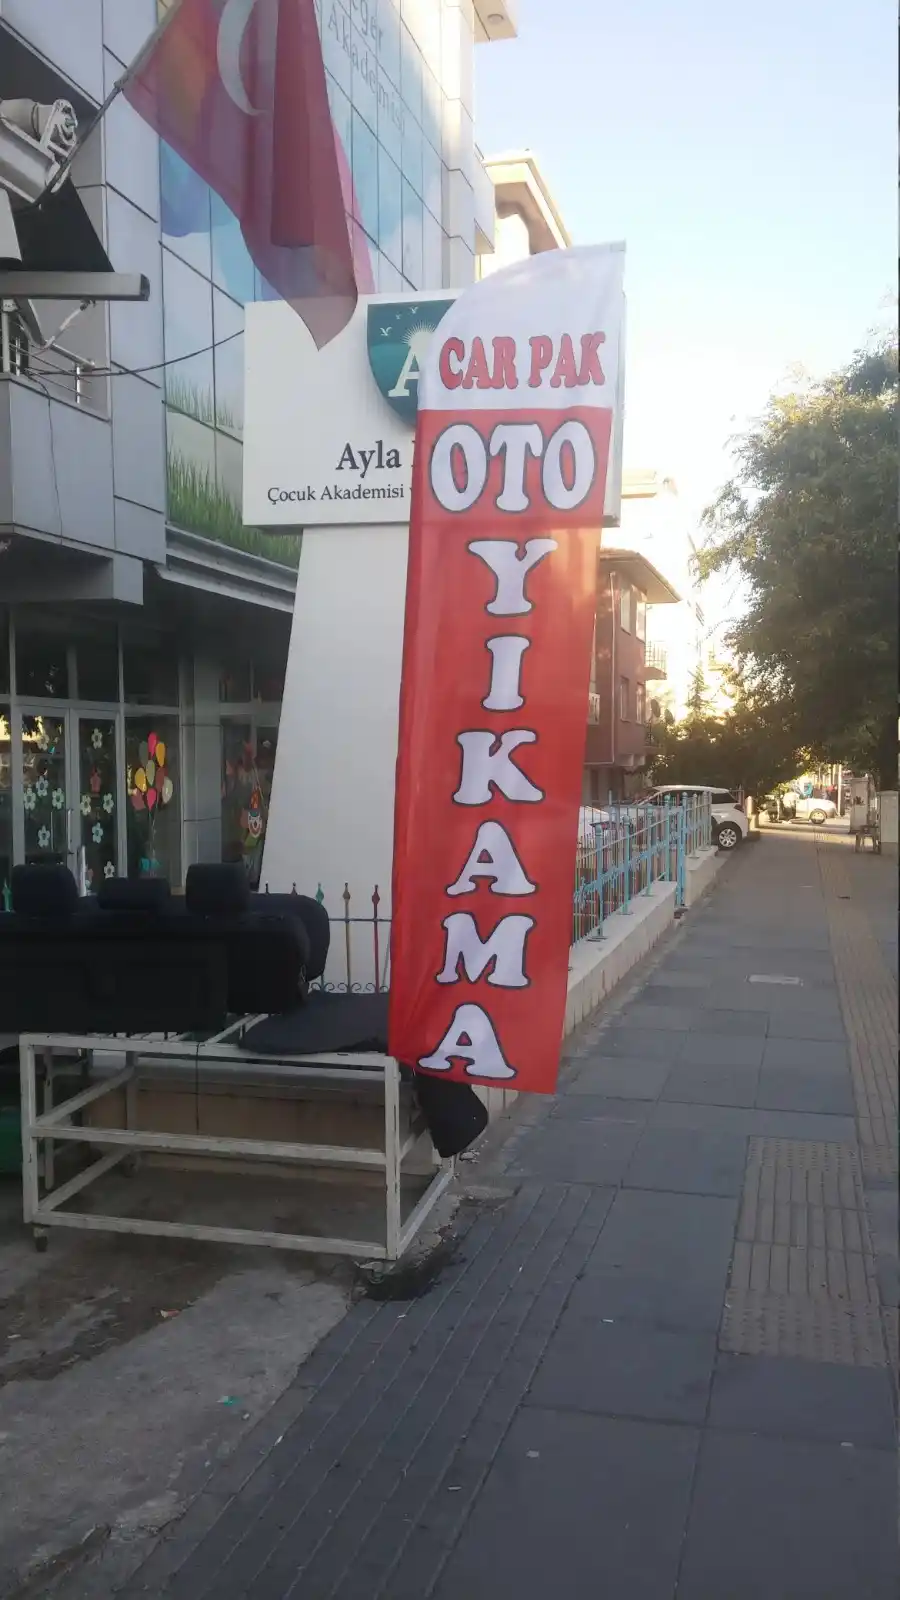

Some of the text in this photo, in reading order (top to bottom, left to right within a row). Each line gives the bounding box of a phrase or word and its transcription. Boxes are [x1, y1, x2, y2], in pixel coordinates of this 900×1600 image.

[327, 2, 405, 137] Akademisi
[438, 331, 606, 390] CAR PAK
[267, 484, 405, 505] Çocuk Akademisi
[335, 439, 402, 478] Ayla
[429, 417, 597, 514] OTO
[417, 538, 558, 1081] YIKAMA
